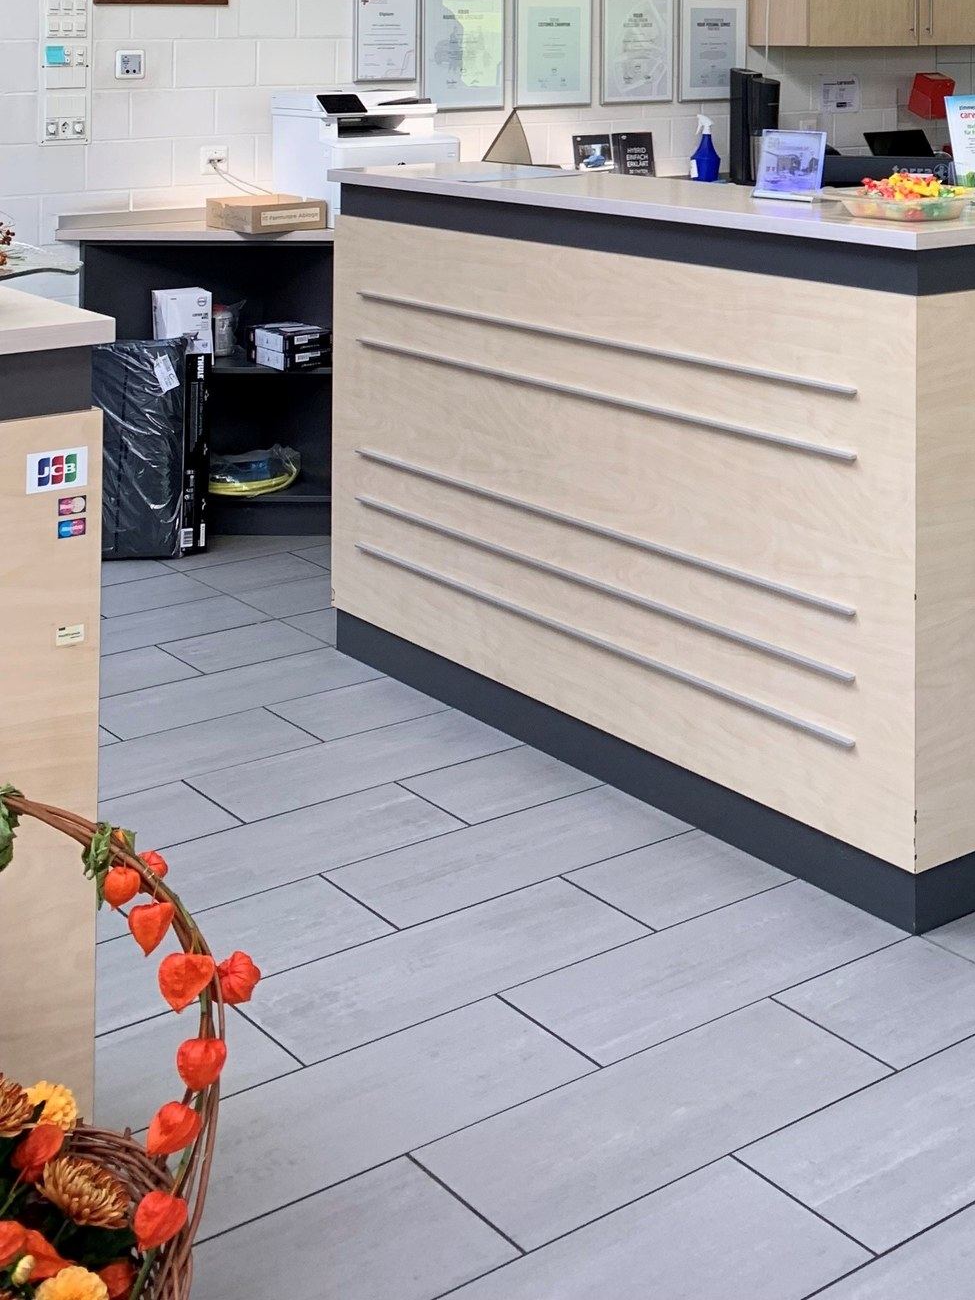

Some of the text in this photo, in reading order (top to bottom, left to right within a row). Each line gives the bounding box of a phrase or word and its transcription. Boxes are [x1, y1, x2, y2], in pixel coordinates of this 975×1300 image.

[625, 153, 649, 161] EINFACH
[626, 160, 649, 168] ERKLÄRT
[197, 355, 205, 380] THULE
